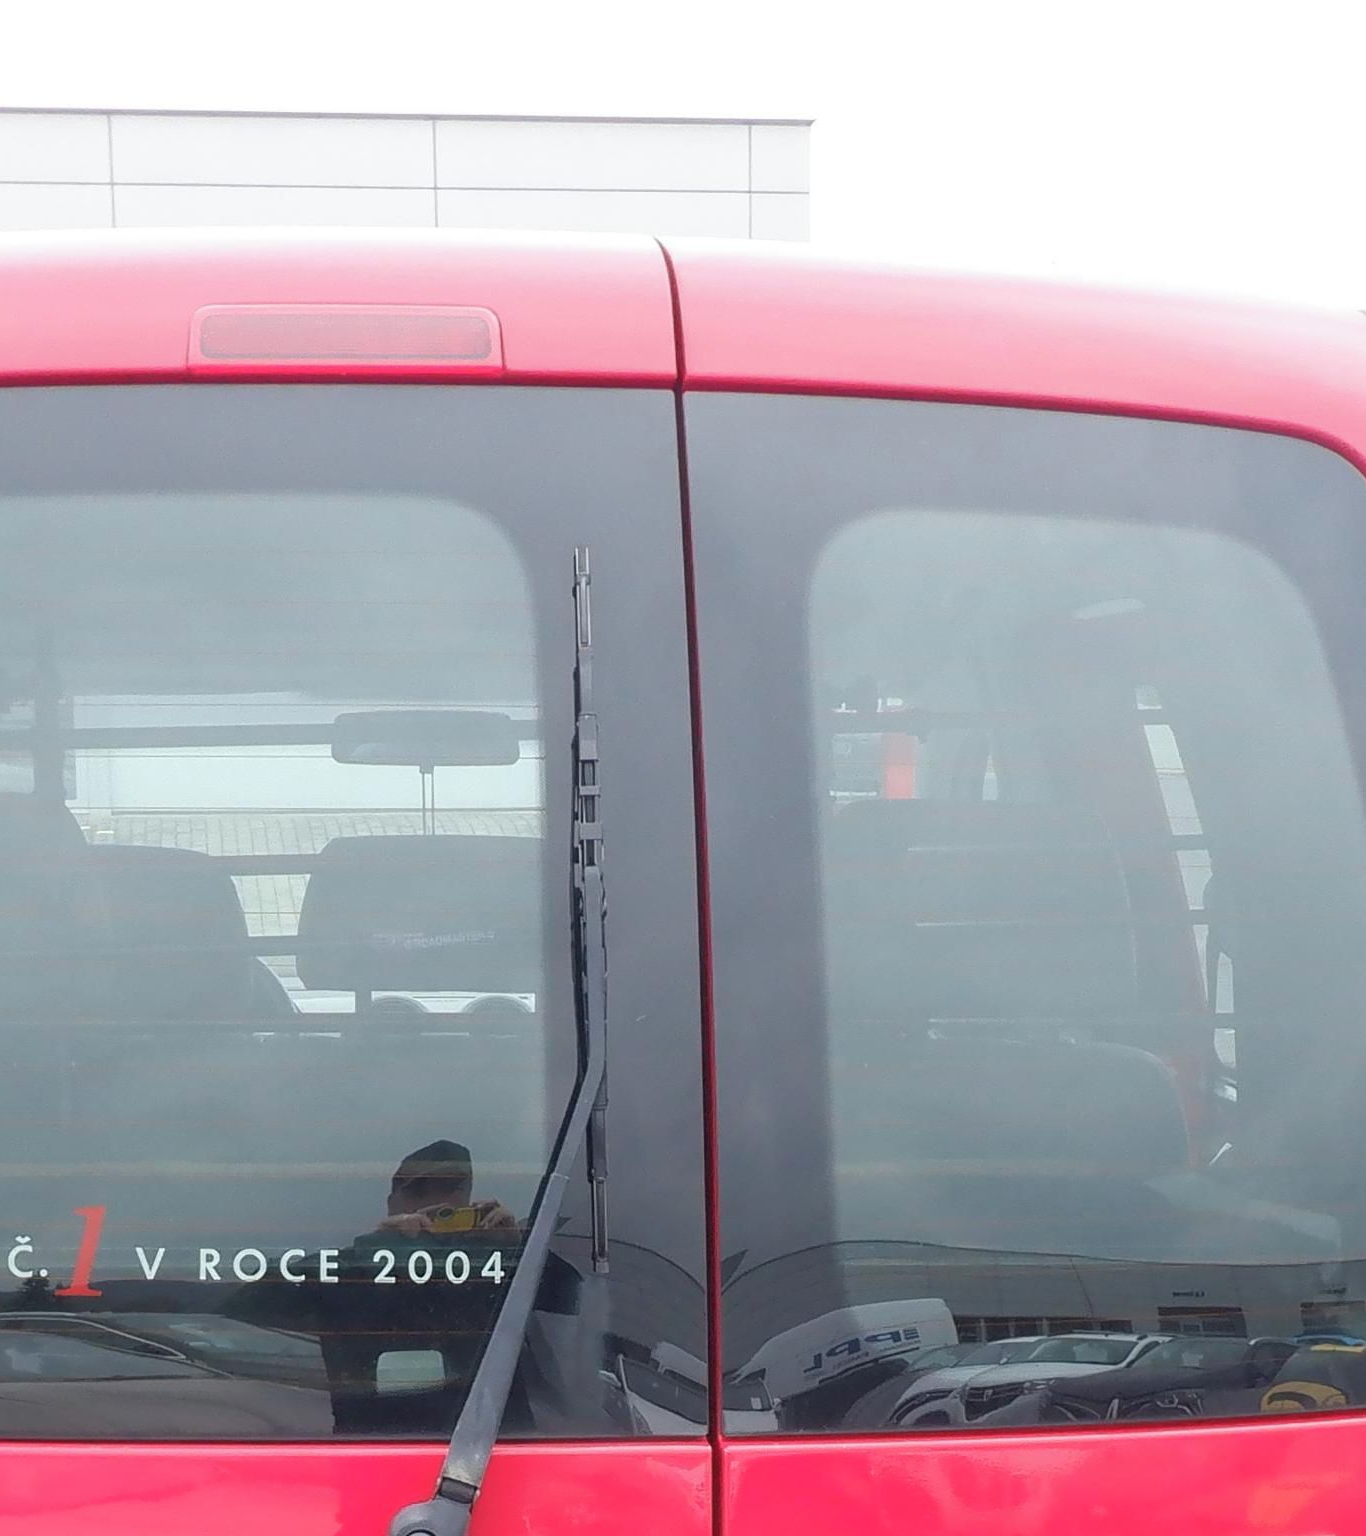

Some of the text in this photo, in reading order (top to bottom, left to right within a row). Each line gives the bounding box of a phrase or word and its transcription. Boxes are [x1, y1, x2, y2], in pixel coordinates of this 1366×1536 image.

[7, 1235, 50, 1279] Č.
[54, 1205, 107, 1297] 1
[135, 1246, 166, 1280] V
[199, 1247, 340, 1283] ROCE
[373, 1249, 505, 1284] 2004
